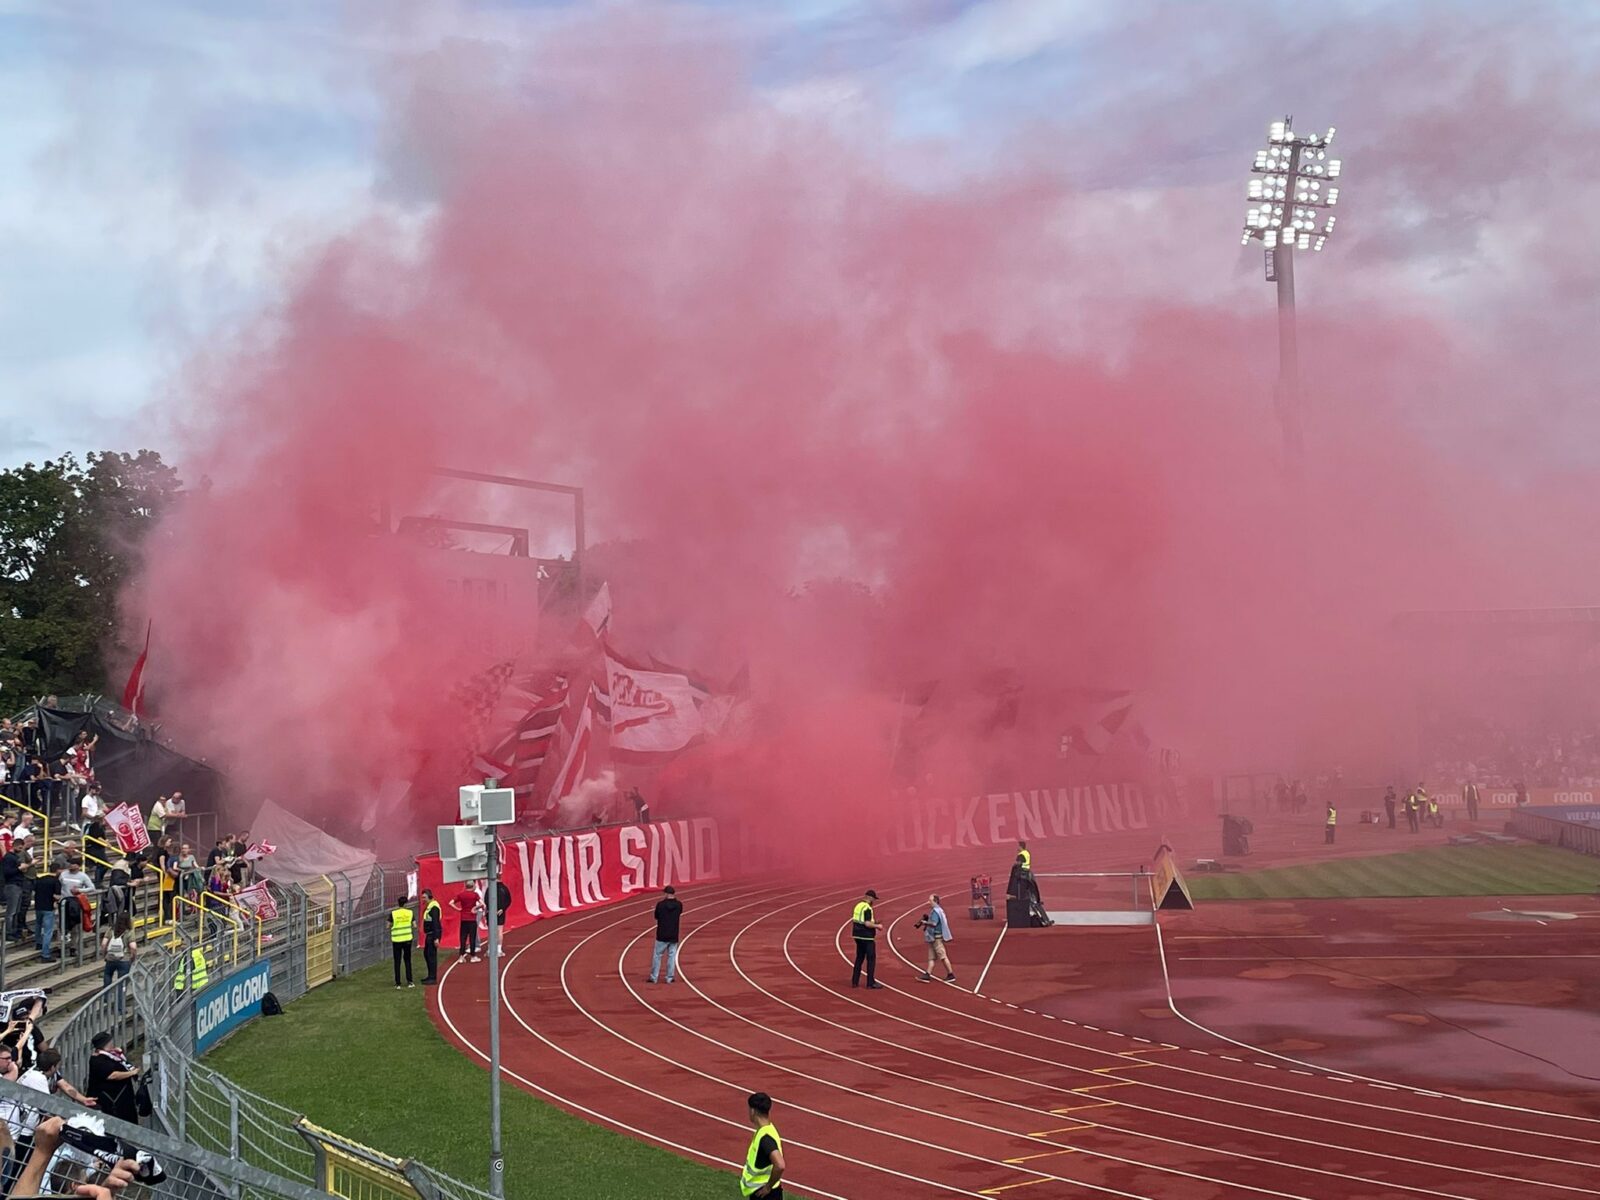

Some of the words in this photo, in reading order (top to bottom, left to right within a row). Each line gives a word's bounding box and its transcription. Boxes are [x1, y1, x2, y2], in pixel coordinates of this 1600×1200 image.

[1553, 791, 1593, 804] roma
[516, 833, 609, 916] WIR
[619, 817, 721, 893] SIND
[197, 992, 230, 1039] GLORIA
[231, 972, 269, 1014] GLORIA
